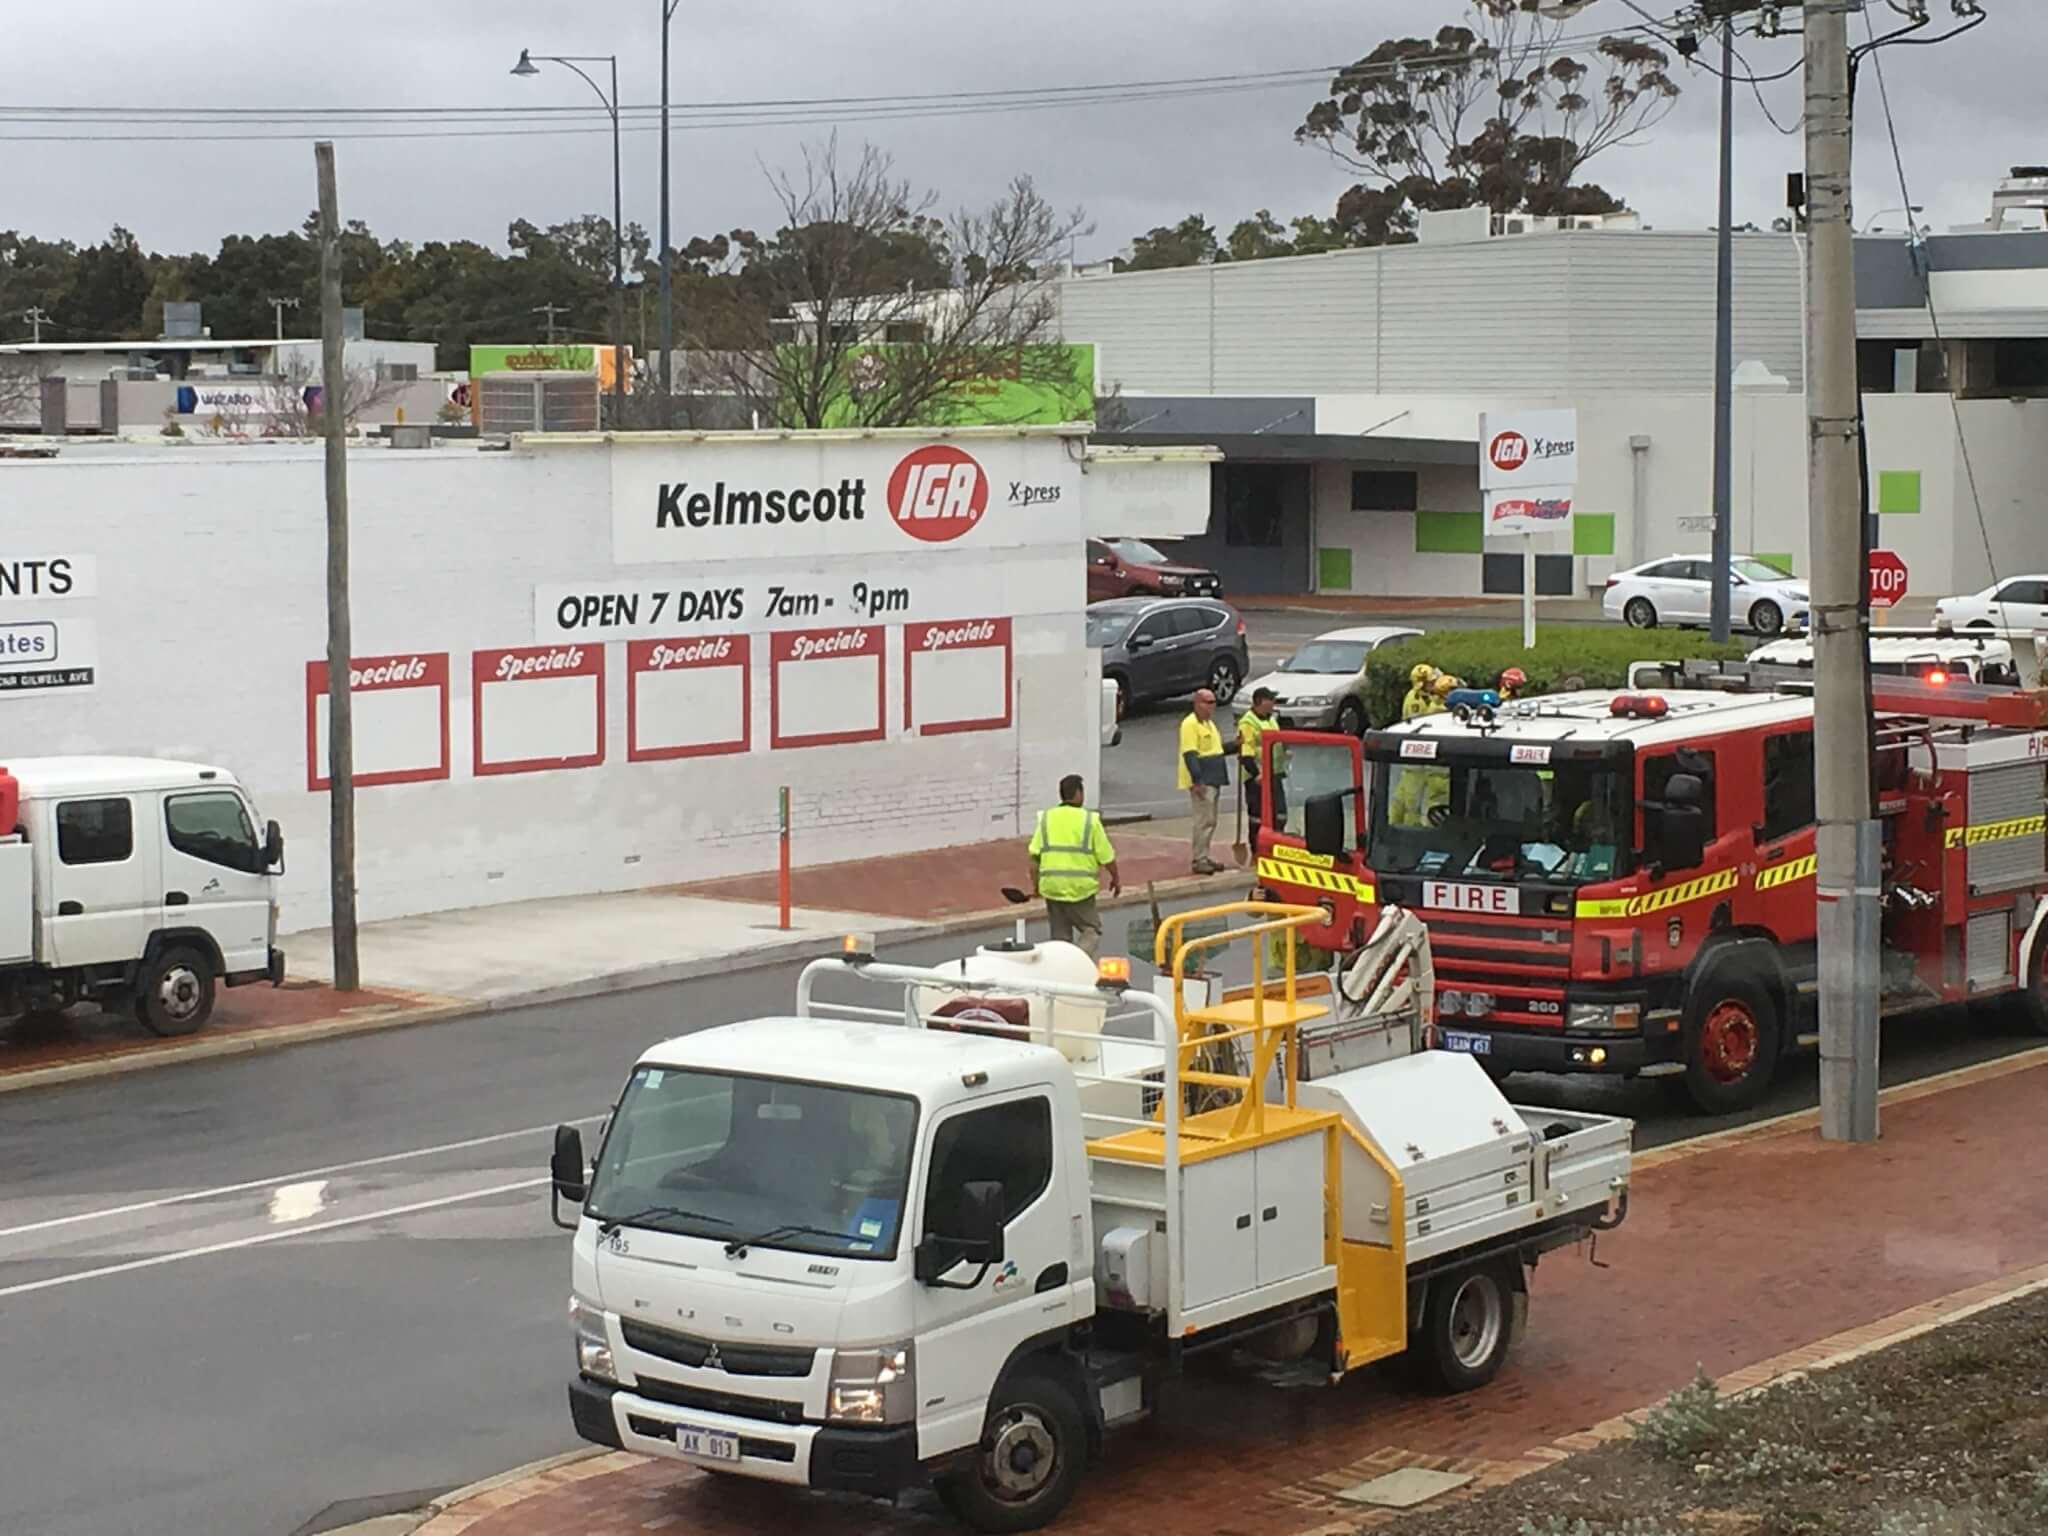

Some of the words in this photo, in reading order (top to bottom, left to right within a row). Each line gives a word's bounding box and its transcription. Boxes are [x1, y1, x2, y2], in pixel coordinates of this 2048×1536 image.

[1494, 438, 1524, 462] IGA
[656, 479, 866, 528] Kelmscott
[898, 463, 977, 520] IGA
[1008, 482, 1061, 506] X-press
[1869, 568, 1905, 591] TOP
[557, 593, 639, 629] OPEN
[649, 592, 670, 624] 7
[677, 588, 745, 622] DAYS
[791, 629, 868, 660] Specials
[923, 621, 995, 651] Specials
[496, 646, 585, 681] Specials
[649, 637, 732, 670] Specials
[350, 657, 427, 687] pecials
[1404, 743, 1432, 755] FIRE
[1434, 884, 1507, 911] FIRE
[634, 1298, 794, 1334] FUSO
